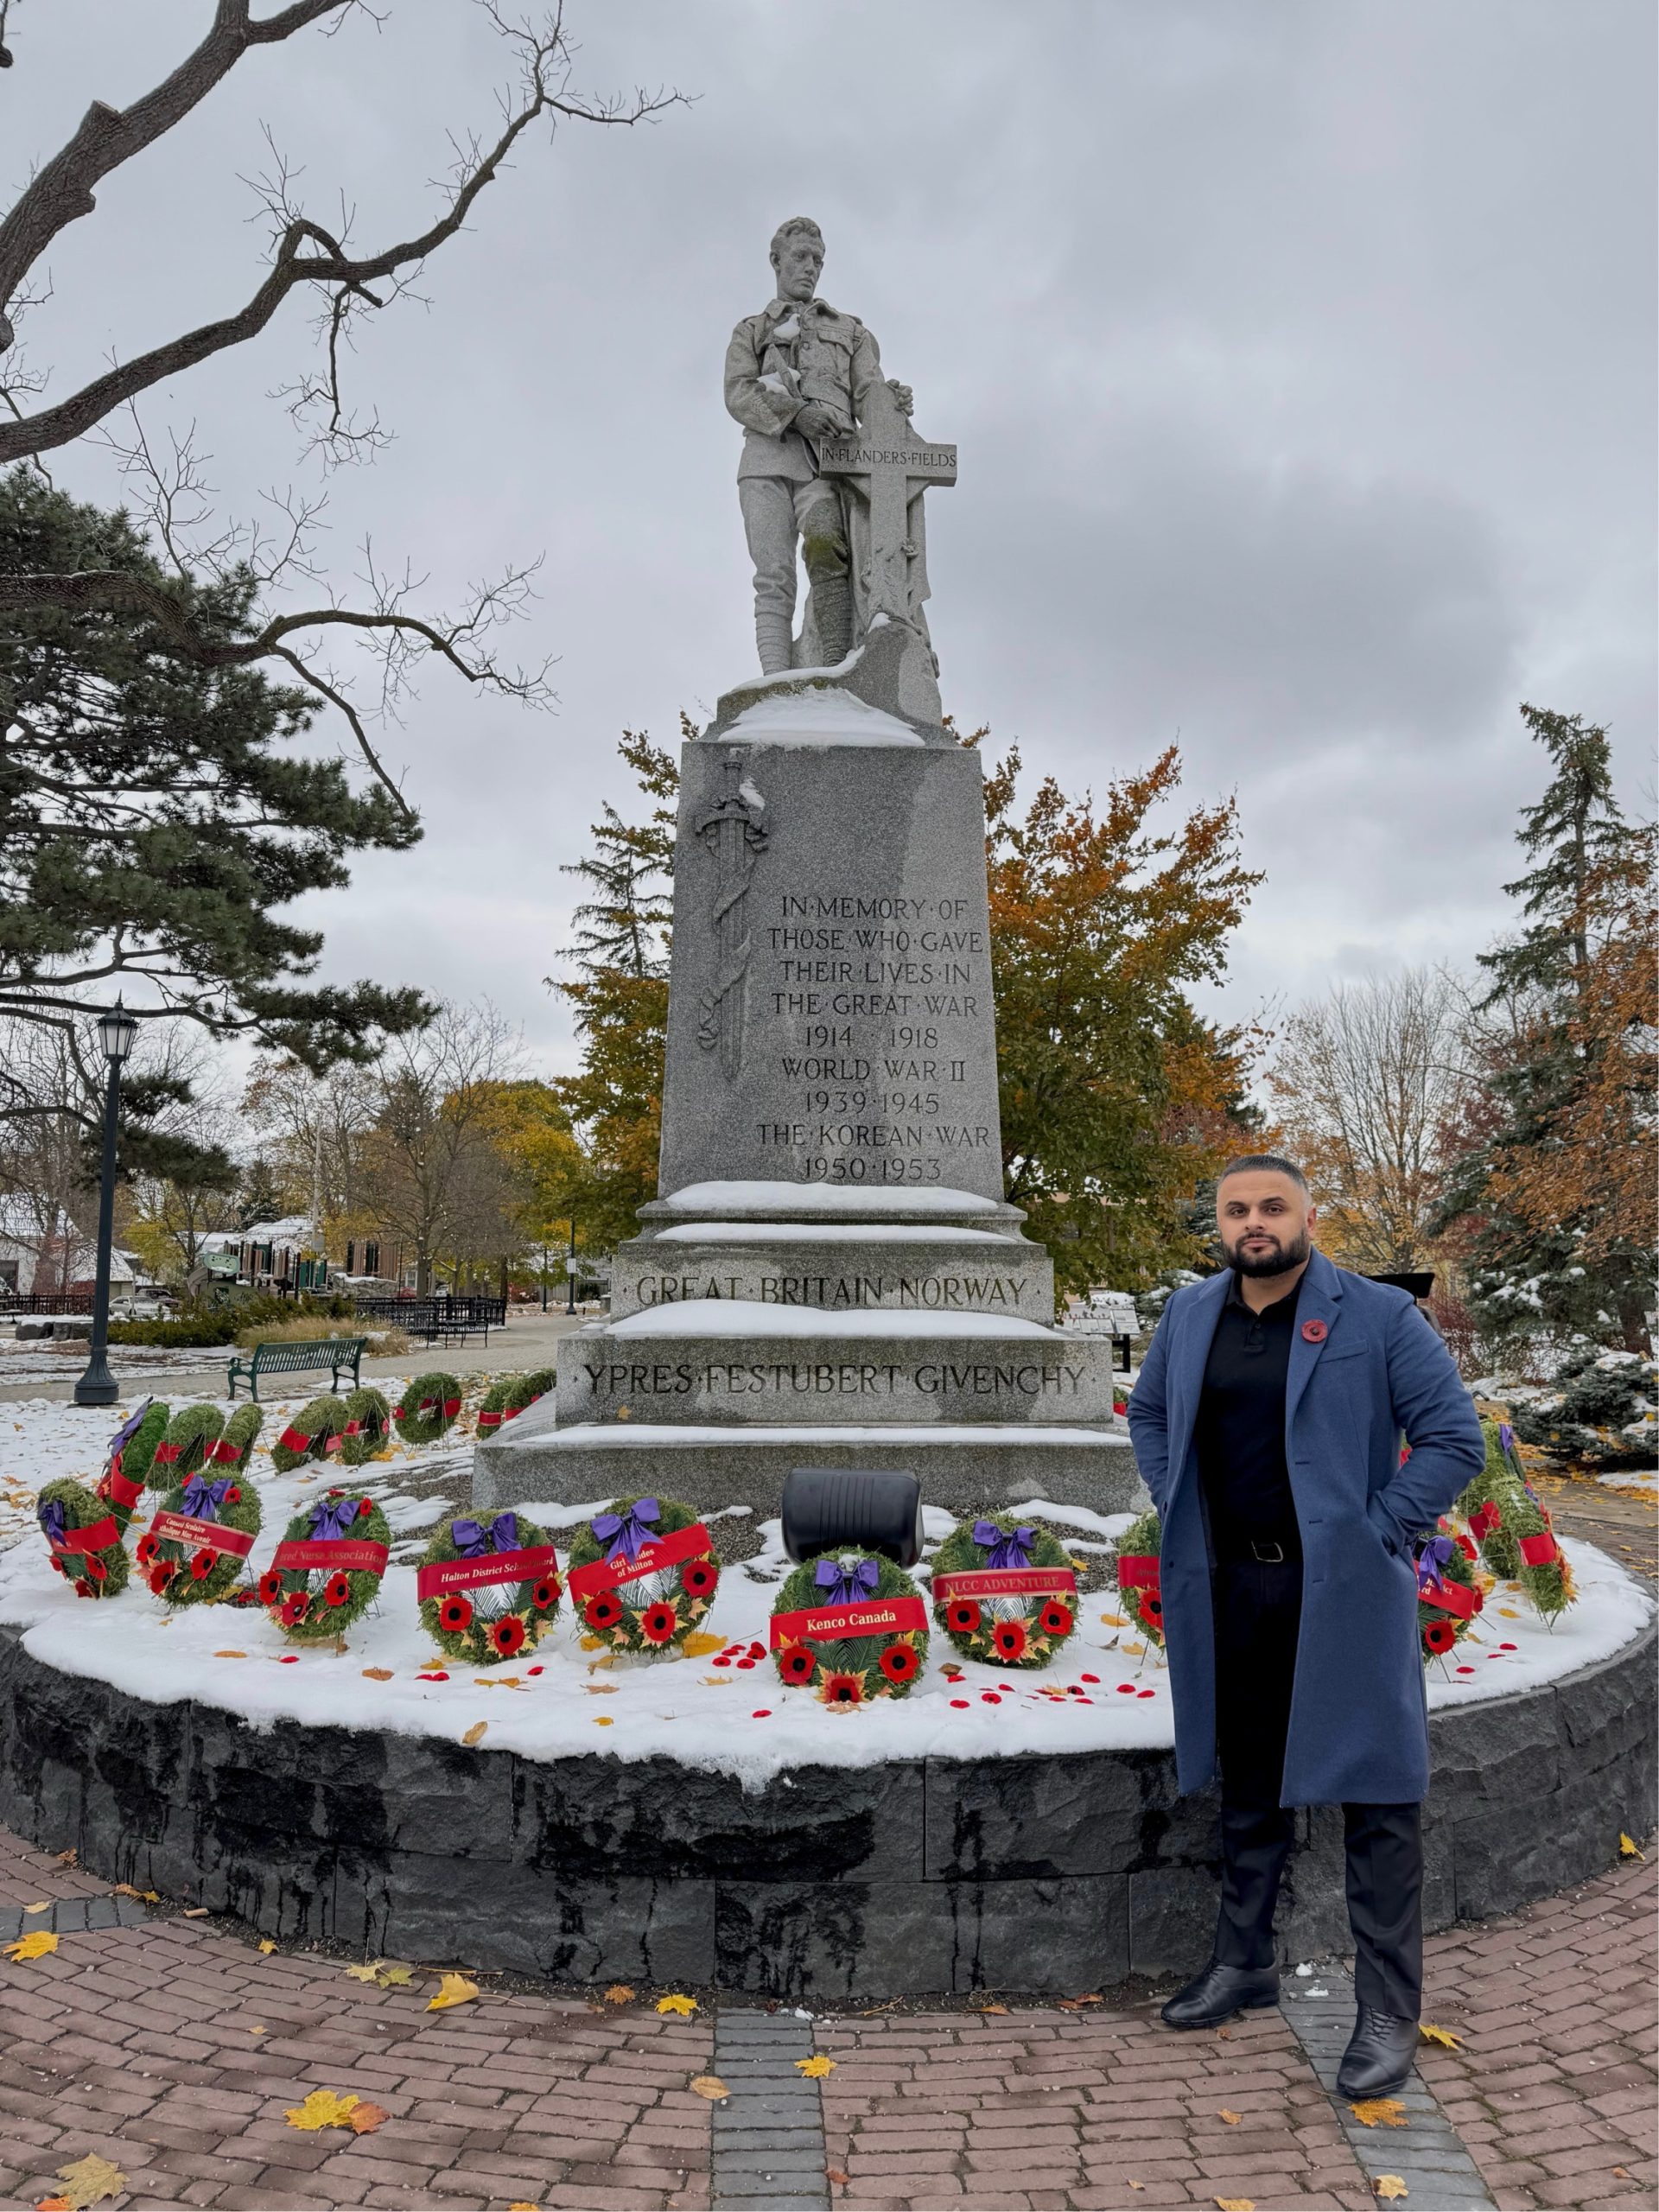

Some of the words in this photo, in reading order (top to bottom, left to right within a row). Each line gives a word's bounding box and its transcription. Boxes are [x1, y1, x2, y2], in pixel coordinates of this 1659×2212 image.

[822, 448, 836, 461] IN
[839, 448, 907, 465] FLANDERS
[912, 453, 957, 467] FIELDS
[782, 896, 807, 917] IN
[817, 897, 928, 919] MEMORY
[938, 899, 968, 920] OF
[767, 929, 845, 950] THOSE
[855, 930, 909, 951] WHO
[920, 931, 983, 952] GAVE
[780, 961, 855, 982] THEIR
[865, 963, 934, 984] LIVES
[944, 963, 970, 984] IN
[772, 993, 822, 1014] THE
[832, 994, 912, 1016] GREAT
[924, 996, 979, 1017] WAR
[805, 1026, 855, 1047] 1914
[891, 1027, 938, 1049] 1918
[782, 1058, 870, 1080] WORLD
[884, 1060, 937, 1082] WAR
[950, 1060, 965, 1081] II
[806, 1091, 866, 1113] 1939
[882, 1092, 939, 1115] 1945
[756, 1124, 805, 1146] THE
[820, 1125, 923, 1147] KOREAN
[936, 1126, 990, 1147] WAR
[805, 1158, 865, 1179] 1950
[882, 1159, 940, 1180] 1953
[637, 1276, 743, 1306] GREAT
[761, 1277, 883, 1306] BRITAIN
[898, 1277, 1027, 1306] NORWAY
[582, 1364, 692, 1394] YPRES
[706, 1364, 902, 1394] FESTUBERT
[914, 1365, 1086, 1394] GIVENCHY
[328, 1549, 385, 1566] Association
[610, 1558, 626, 1570] Girl
[617, 1568, 626, 1578] of
[627, 1560, 654, 1573] Milton
[441, 1571, 470, 1583] Halton
[472, 1566, 502, 1578] District
[944, 1580, 980, 1592] NLCC
[982, 1576, 1059, 1591] ADVENTURE
[807, 1618, 845, 1631] Kenco
[849, 1610, 896, 1625] Canada
